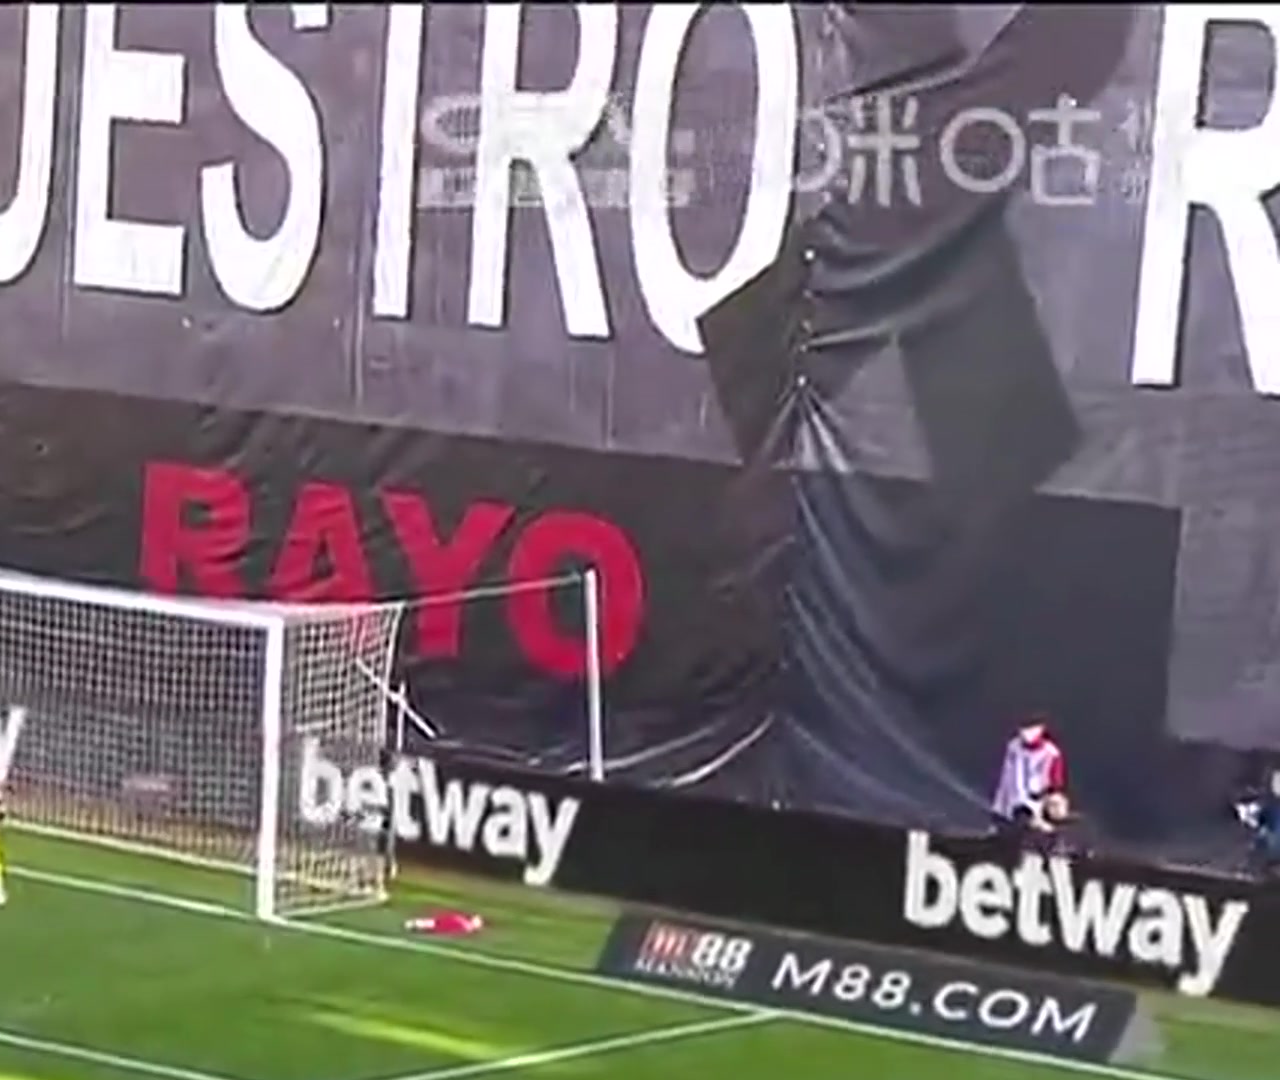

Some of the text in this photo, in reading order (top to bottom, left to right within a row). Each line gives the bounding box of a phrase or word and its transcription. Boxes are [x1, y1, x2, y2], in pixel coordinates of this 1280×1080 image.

[142, 460, 646, 681] RAYO
[300, 737, 581, 885] betway
[902, 830, 1248, 996] betway
[772, 952, 1097, 1043] M88.COM
